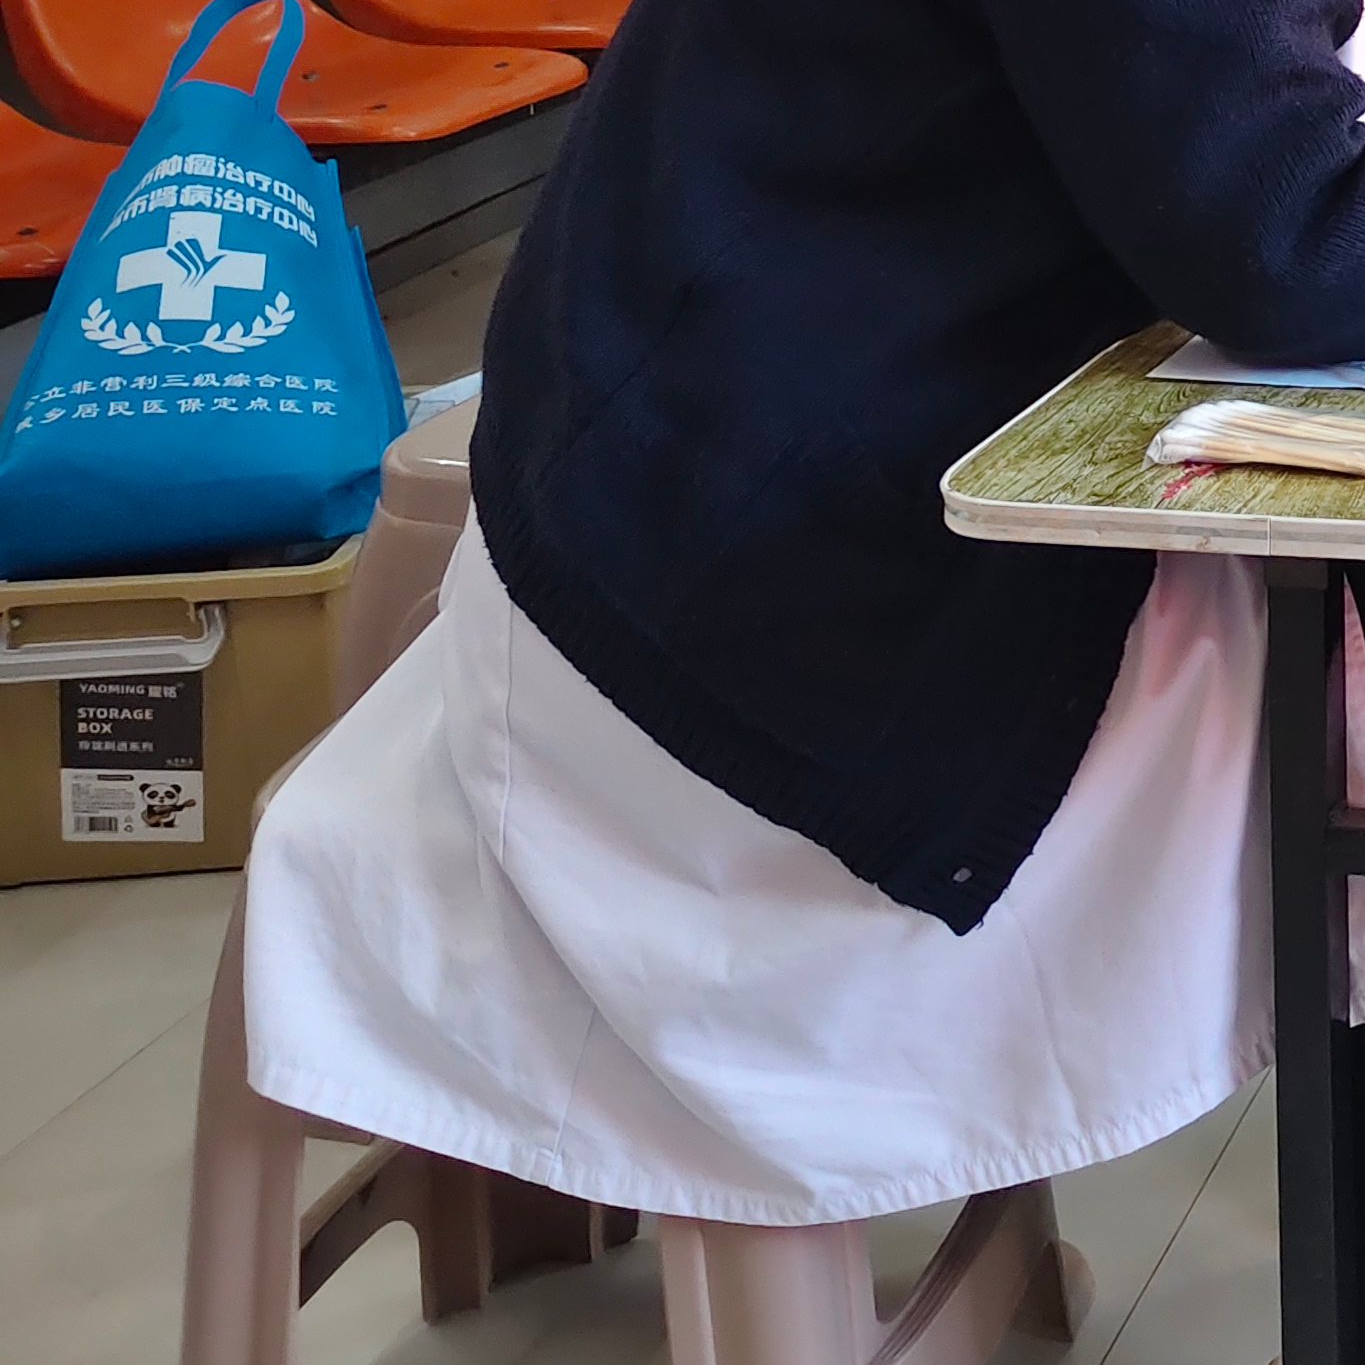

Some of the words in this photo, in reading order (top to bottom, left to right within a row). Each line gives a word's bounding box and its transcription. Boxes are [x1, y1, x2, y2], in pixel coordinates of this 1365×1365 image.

[79, 682, 146, 695] YAOMING
[77, 706, 154, 720] STORAGE
[77, 721, 113, 734] BOX
